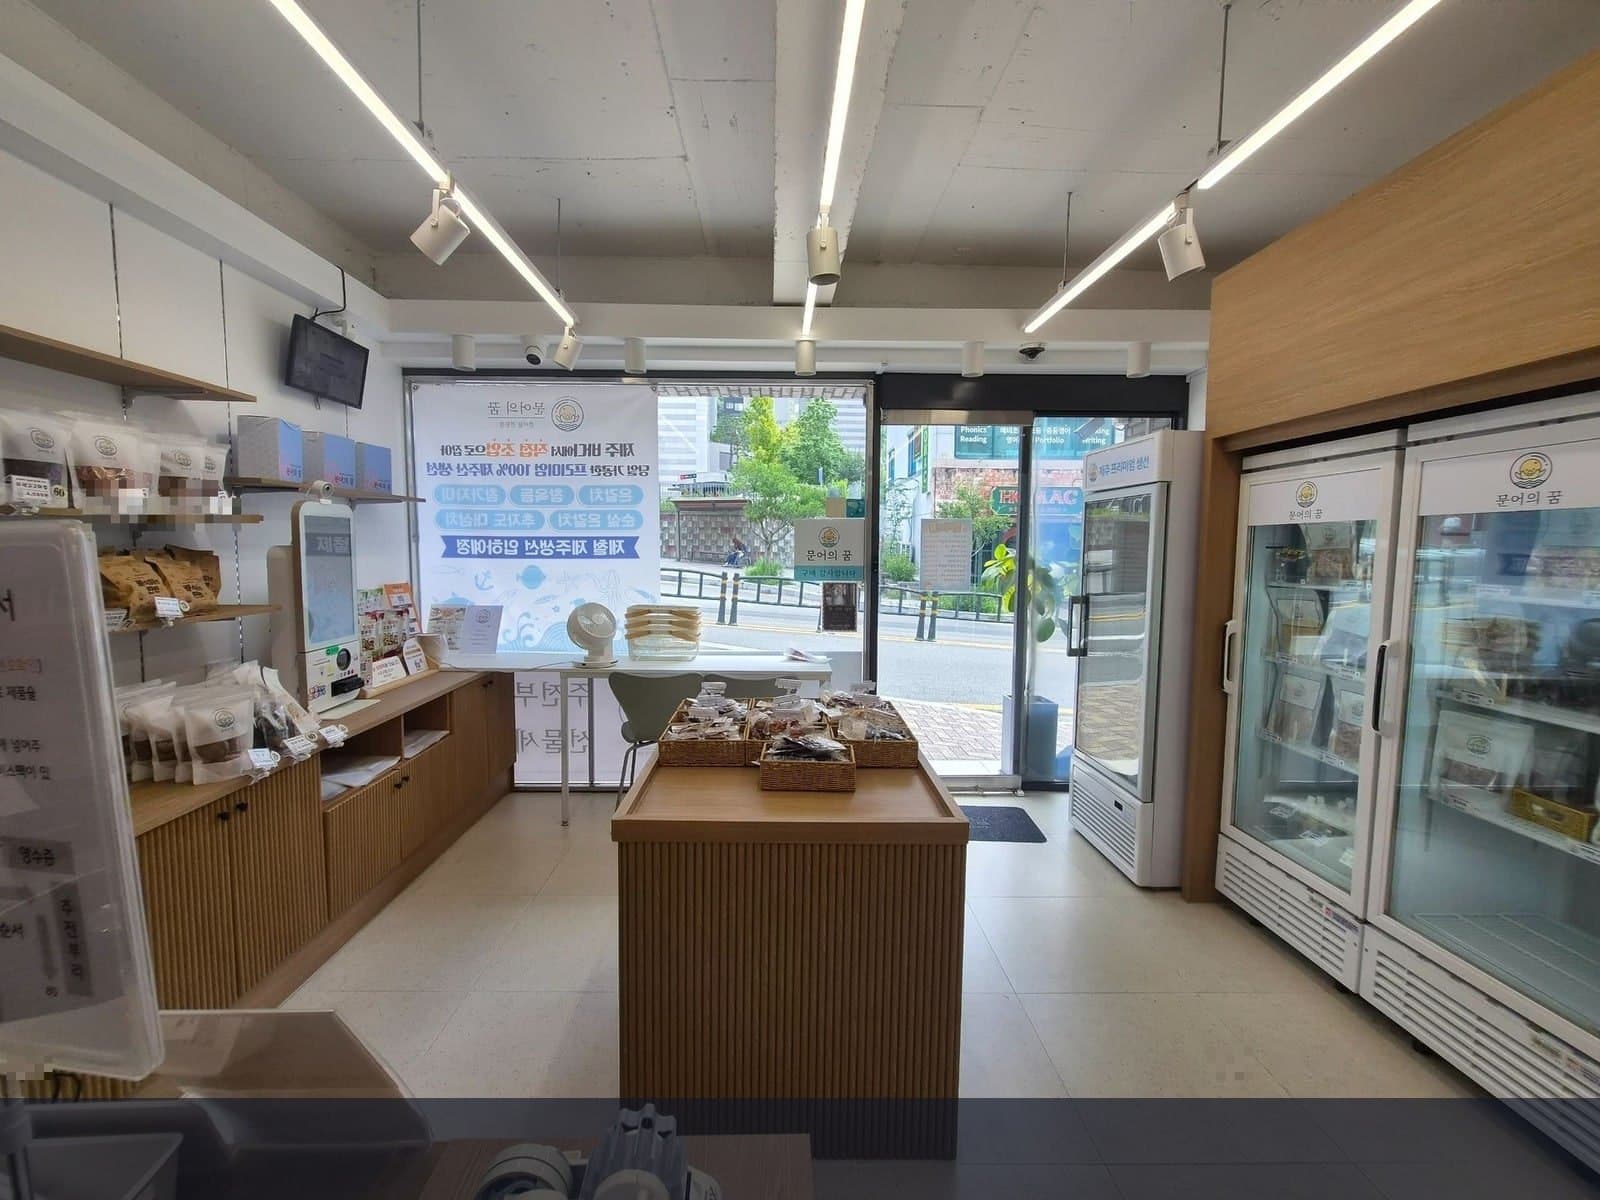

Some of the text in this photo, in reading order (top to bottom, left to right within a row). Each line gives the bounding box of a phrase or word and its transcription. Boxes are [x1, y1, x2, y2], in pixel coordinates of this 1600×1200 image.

[960, 434, 988, 444] Reading
[1496, 490, 1564, 508] 문어의 꿈
[1289, 508, 1323, 521] 문어의 꿈
[807, 549, 853, 561] 문어의 꿈
